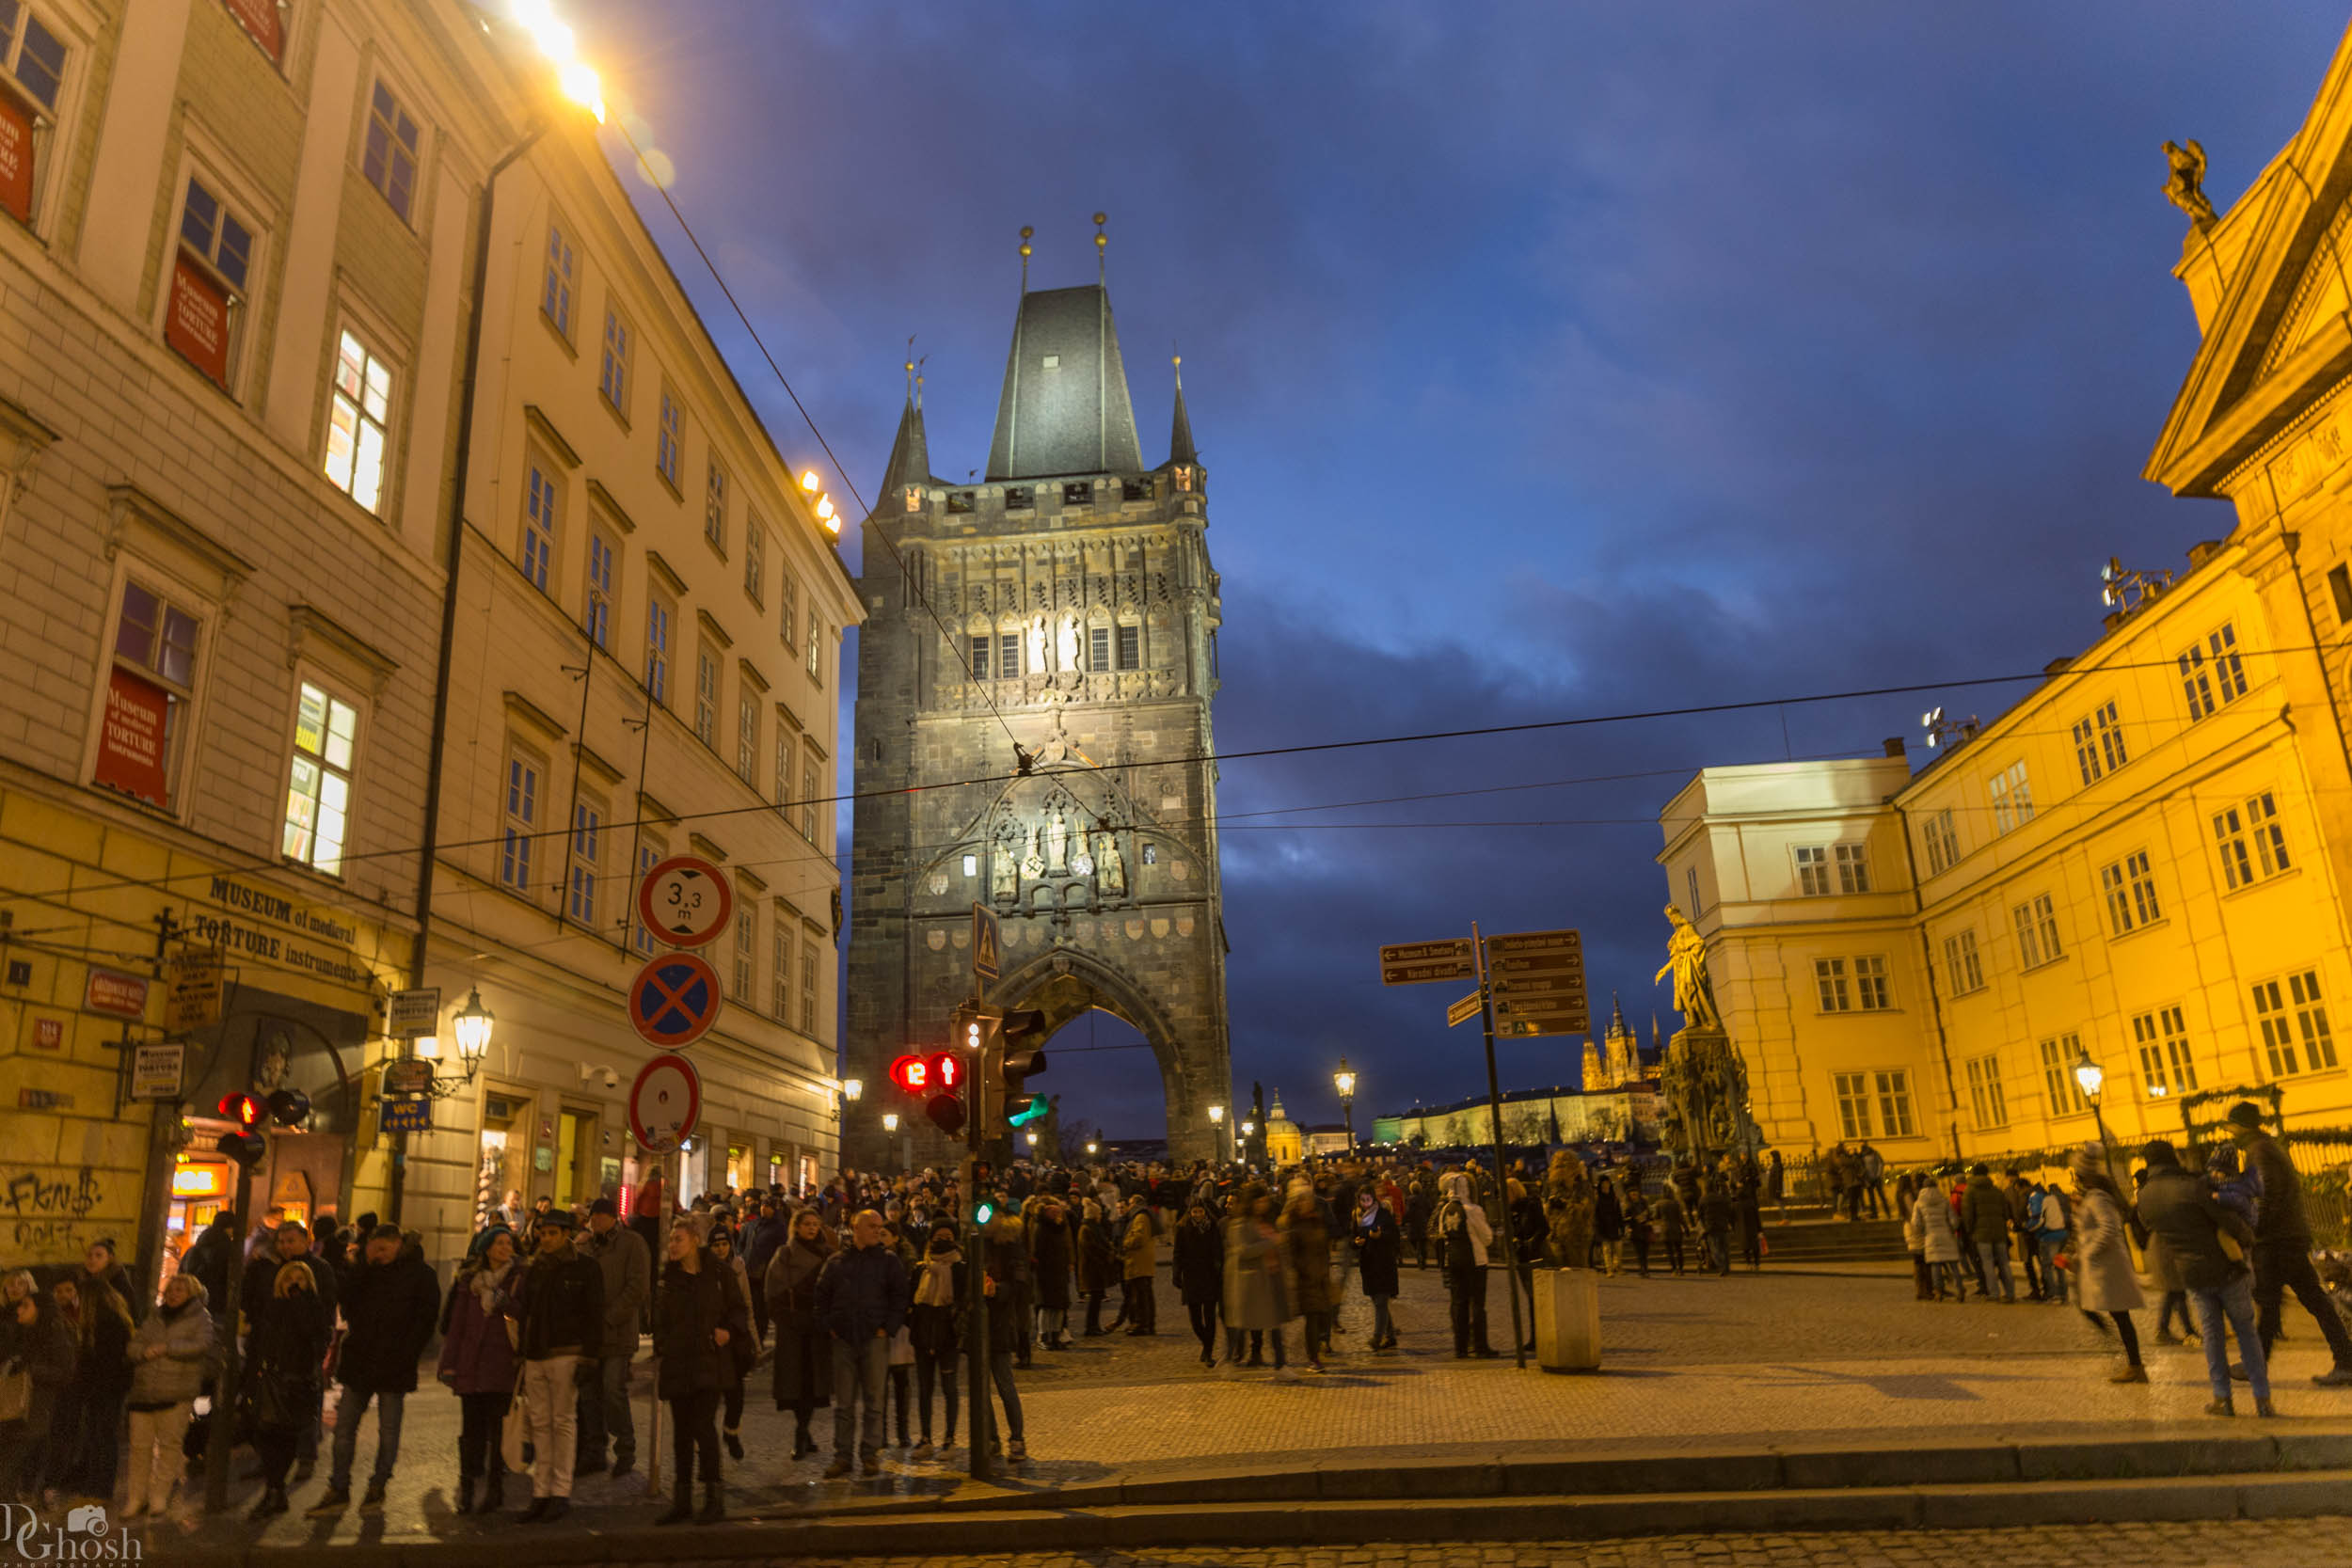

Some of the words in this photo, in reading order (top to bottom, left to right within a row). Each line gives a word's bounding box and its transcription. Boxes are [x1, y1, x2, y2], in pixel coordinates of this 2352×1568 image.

[107, 688, 156, 725] Museum
[107, 721, 156, 756] TORTURE
[210, 876, 292, 924] MUSEUM
[294, 911, 308, 928] of
[309, 915, 357, 944] medieval
[677, 910, 691, 920] m
[195, 914, 281, 960] TORTURE
[285, 942, 358, 982] instruments
[907, 1063, 926, 1085] 12
[393, 1103, 418, 1115] WC
